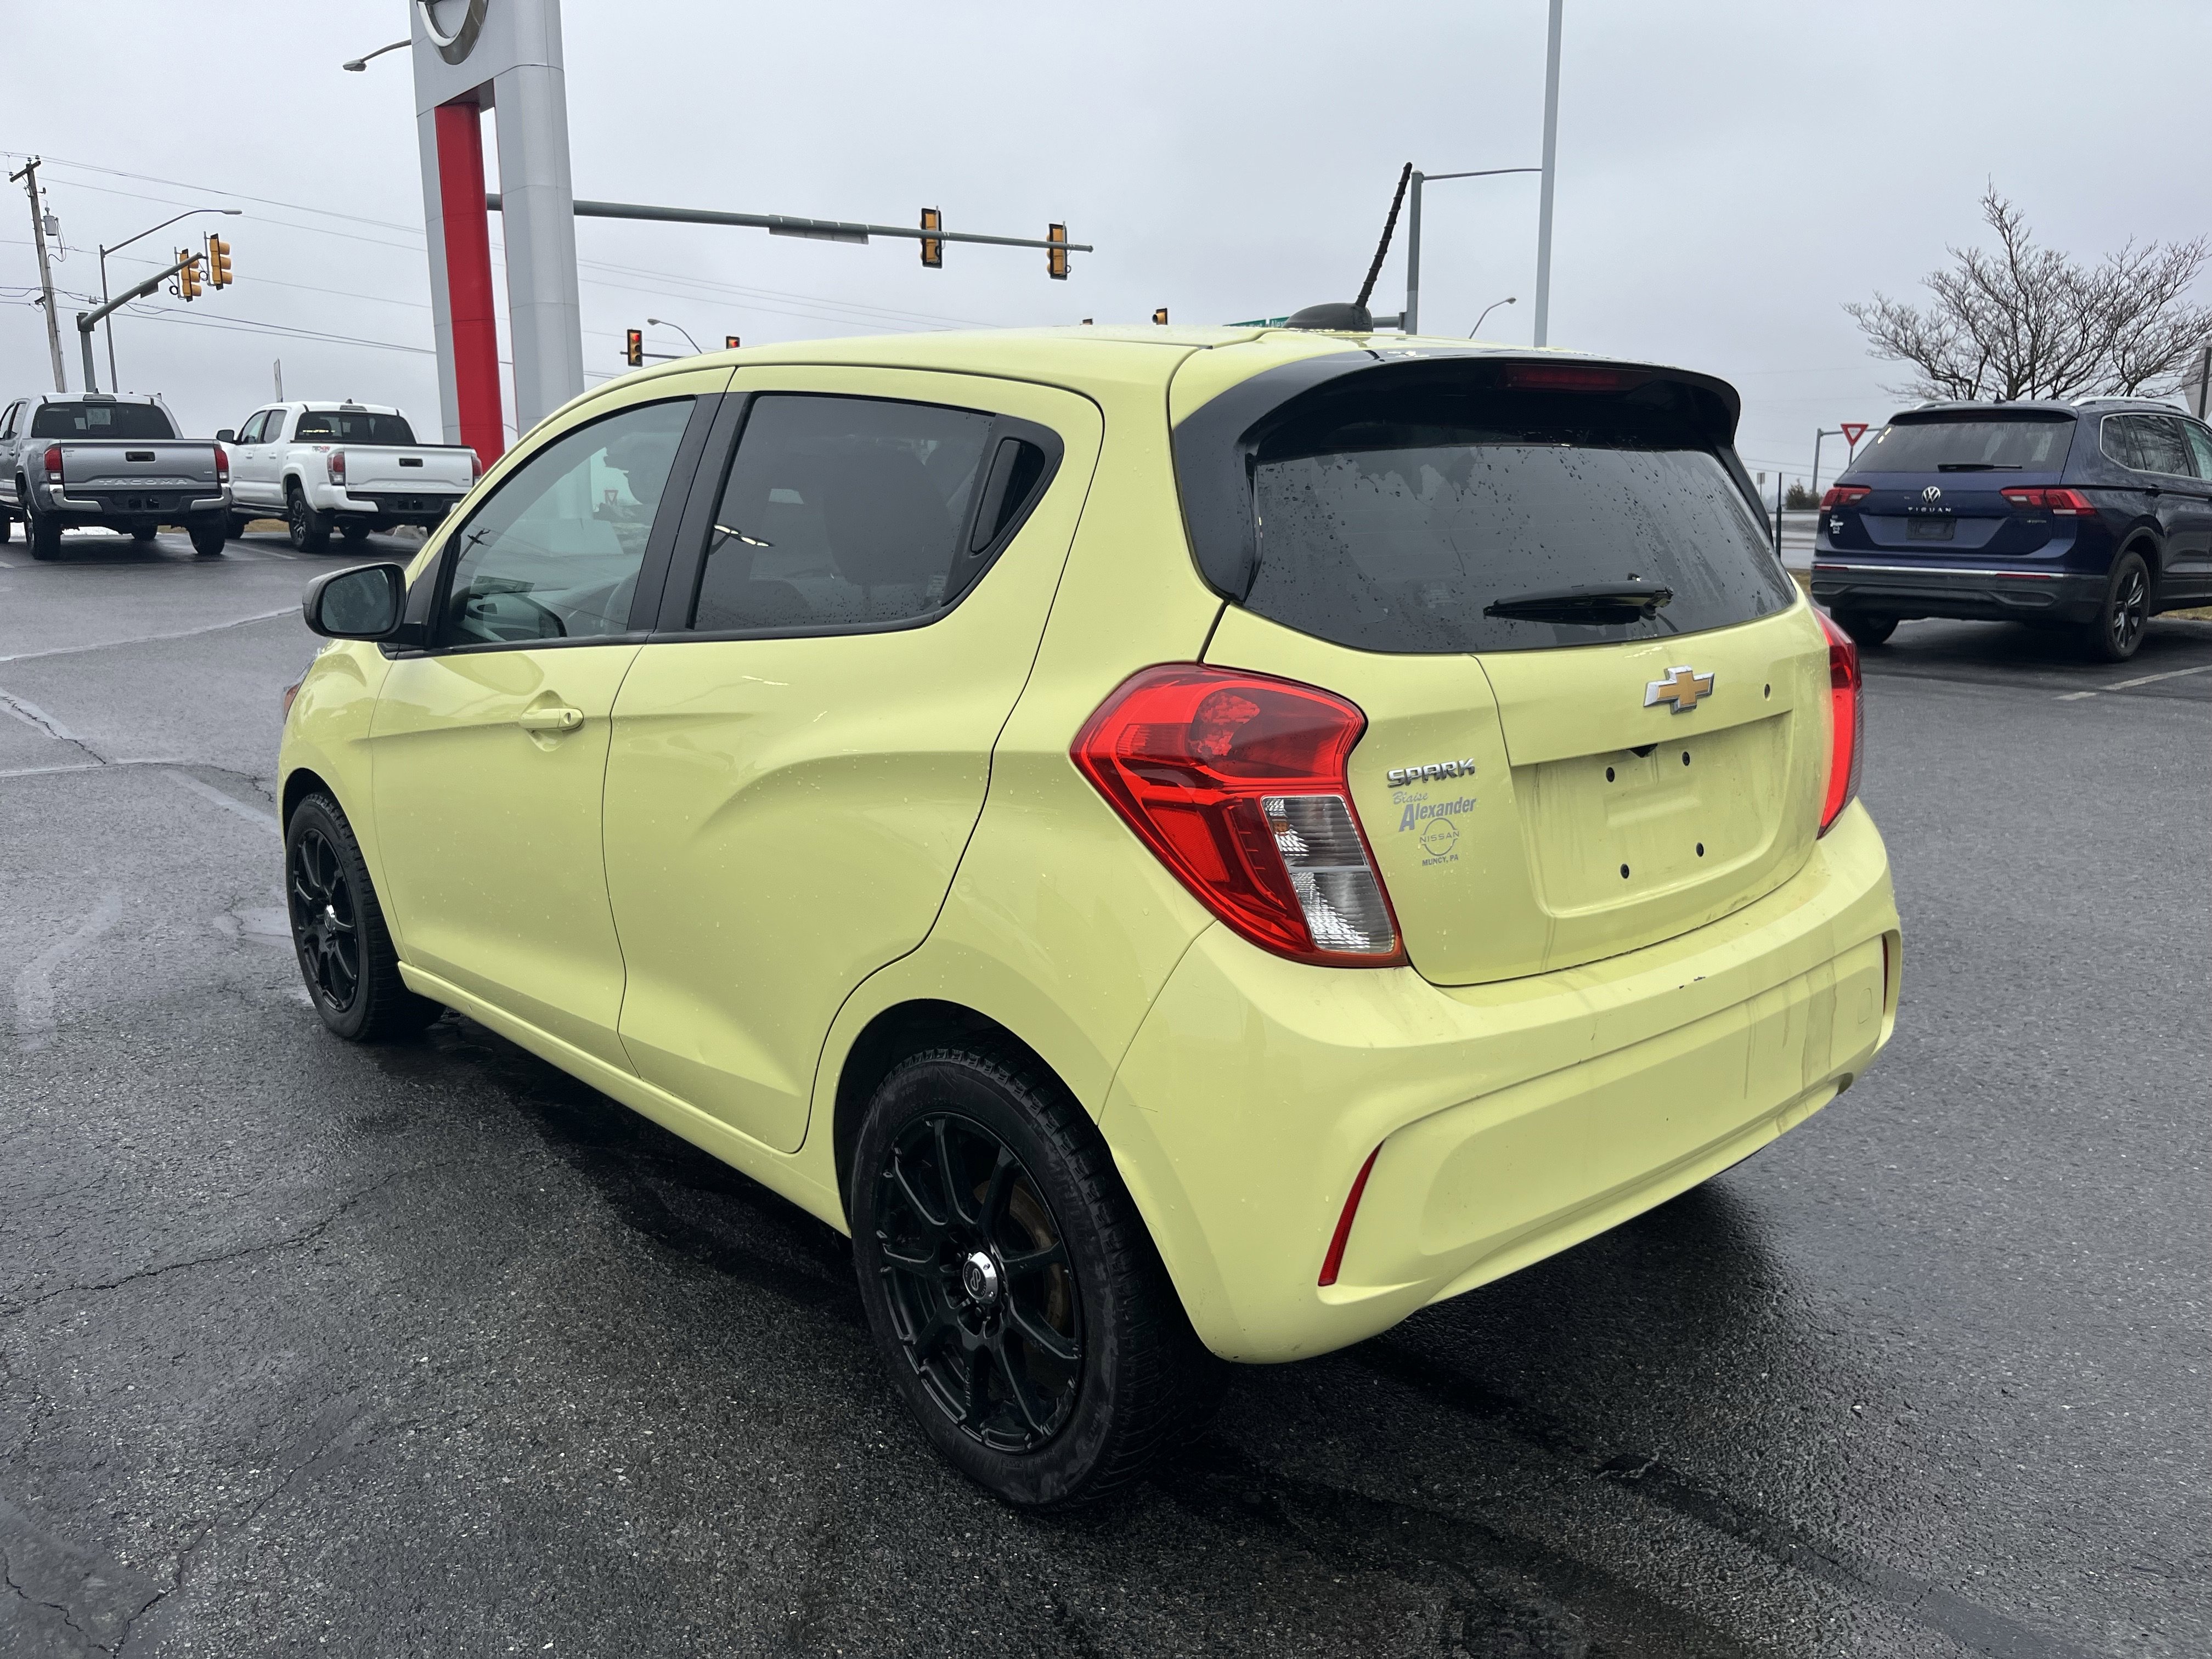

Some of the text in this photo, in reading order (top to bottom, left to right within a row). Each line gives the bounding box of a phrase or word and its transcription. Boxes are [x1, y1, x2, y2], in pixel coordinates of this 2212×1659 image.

[1387, 758, 1475, 788] SPARK
[1392, 791, 1429, 805] Blaise
[1398, 797, 1477, 832] Alexander
[1419, 830, 1460, 844] NISSAN
[1422, 854, 1459, 866] MUNCY, PA
